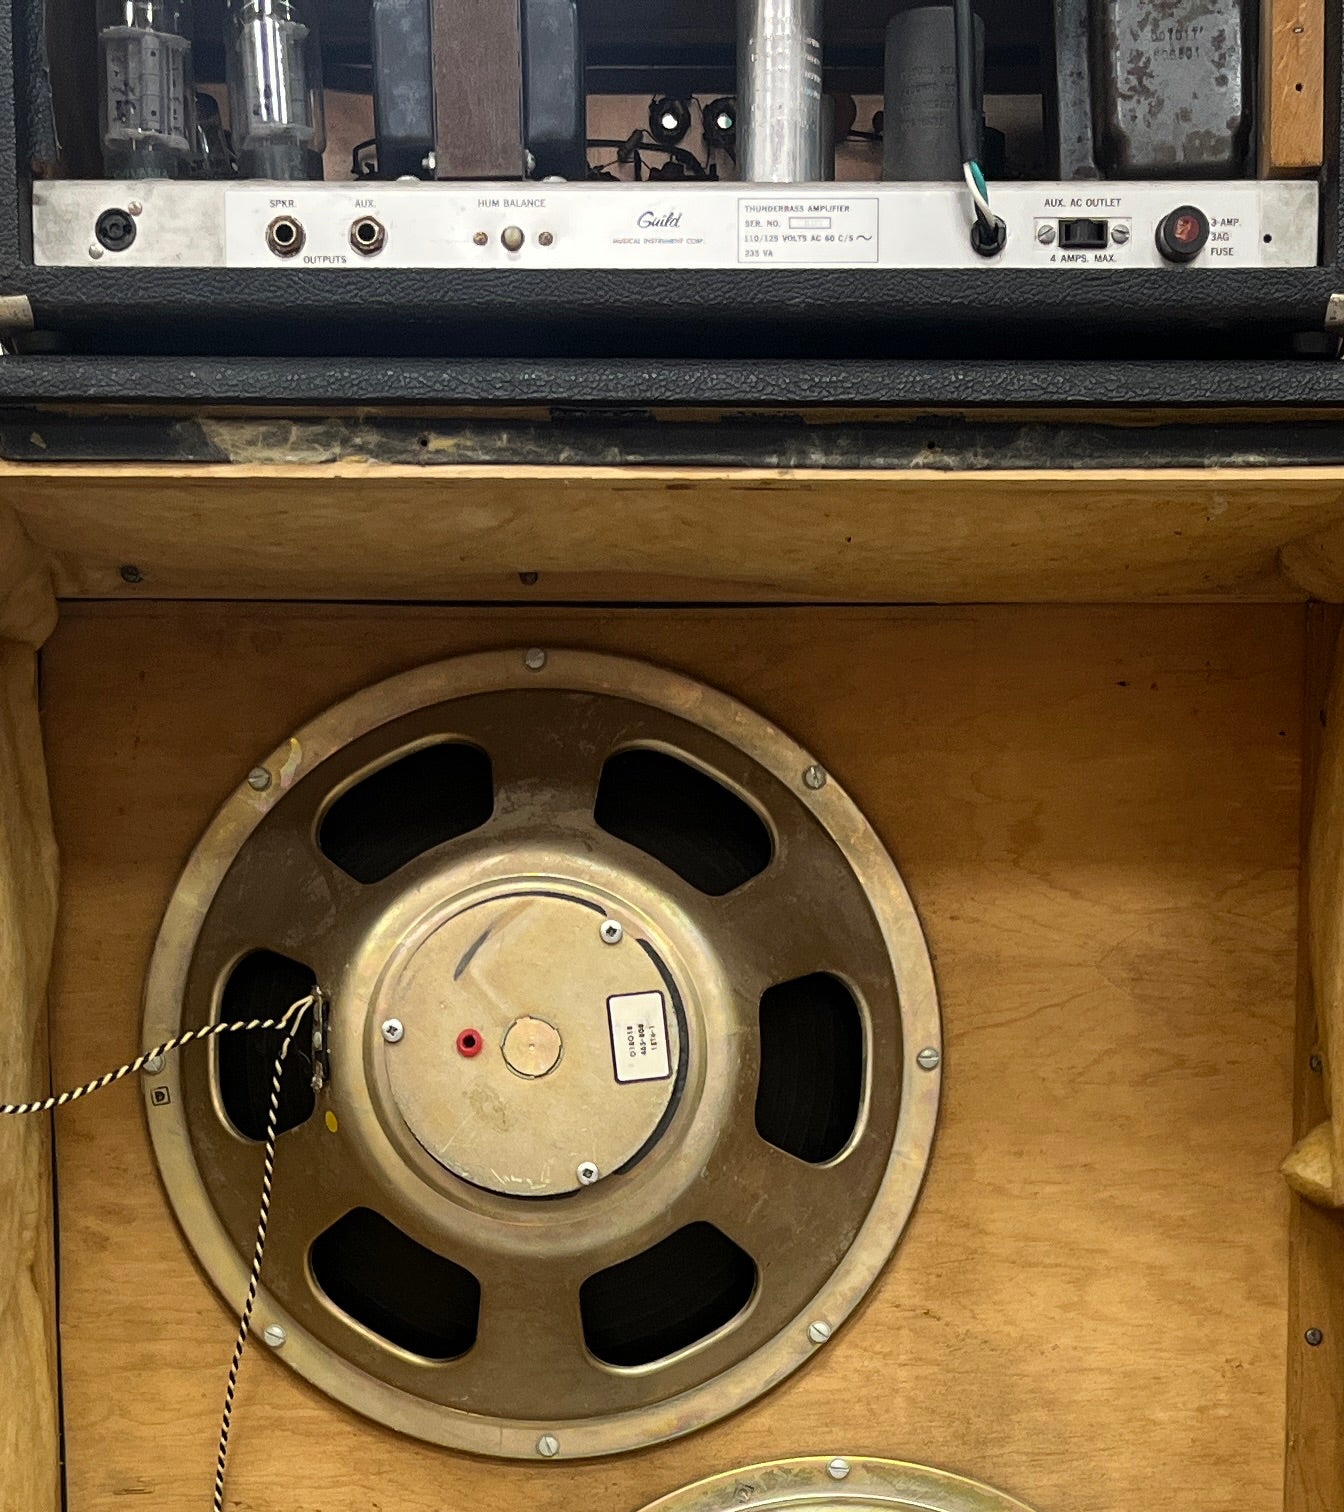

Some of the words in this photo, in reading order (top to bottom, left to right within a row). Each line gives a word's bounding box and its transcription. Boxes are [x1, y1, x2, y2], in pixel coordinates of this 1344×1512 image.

[269, 199, 297, 208] SPKR.
[354, 199, 377, 208] AUX.
[477, 199, 500, 208] HUM
[503, 199, 546, 208] BALANCE
[1044, 198, 1066, 207] AUX.
[1070, 198, 1083, 207] AC
[1085, 198, 1122, 207] OUTLET
[744, 205, 804, 213] THUNDERBASS
[807, 205, 850, 213] AMPLIFIER
[637, 210, 682, 229] Guild
[782, 234, 807, 243] VOLTS
[810, 234, 821, 242] AC
[824, 234, 835, 242] 60
[1210, 232, 1230, 242] 3AG
[1210, 247, 1234, 256] FUSE
[303, 255, 347, 264] OUTPUTS
[1050, 254, 1056, 263] 4
[1060, 254, 1089, 263] AMPS.
[1094, 254, 1117, 263] MAX.
